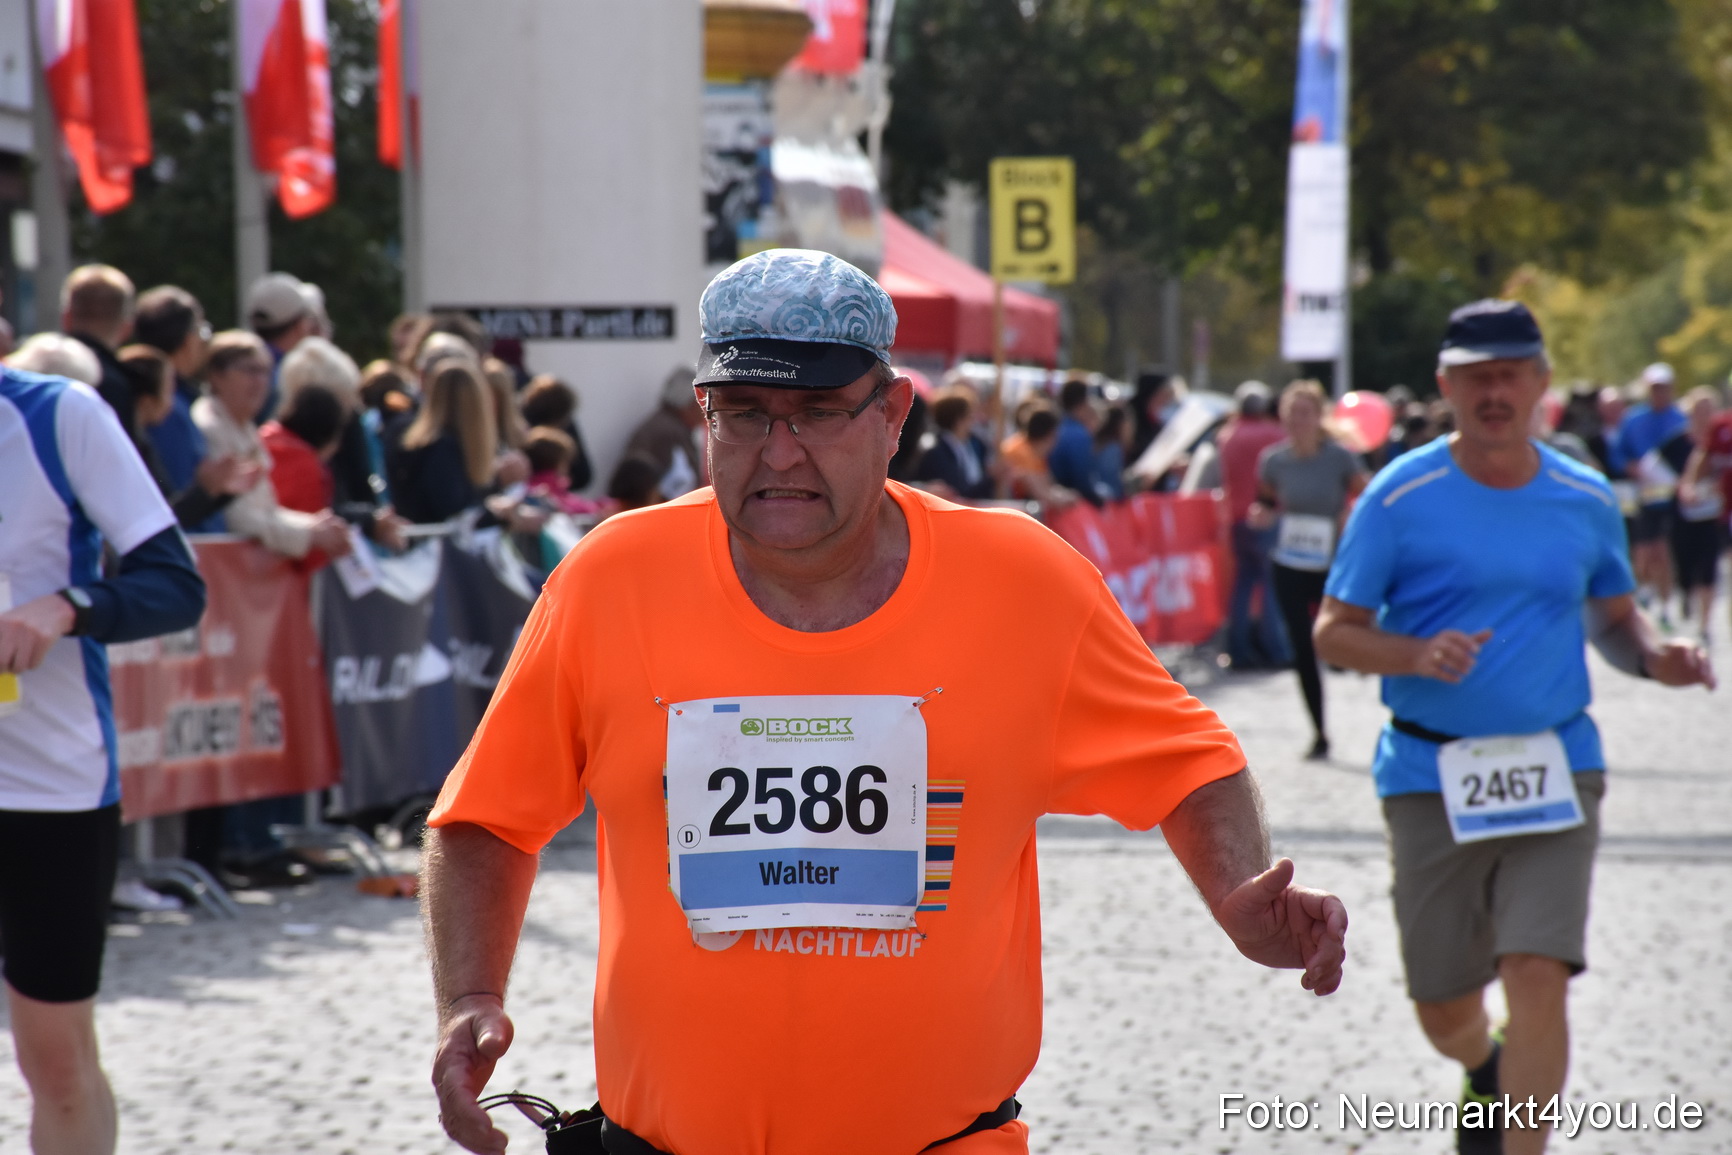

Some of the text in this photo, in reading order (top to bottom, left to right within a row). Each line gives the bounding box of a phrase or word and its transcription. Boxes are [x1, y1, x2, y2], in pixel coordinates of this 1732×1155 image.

[1015, 198, 1050, 252] B
[767, 718, 853, 735] BOCK
[825, 735, 855, 743] concepts
[1462, 764, 1548, 808] 2467
[707, 765, 889, 837] 2586
[685, 831, 693, 843] D
[759, 860, 839, 886] Walter
[753, 929, 922, 957] NACHTLAUF
